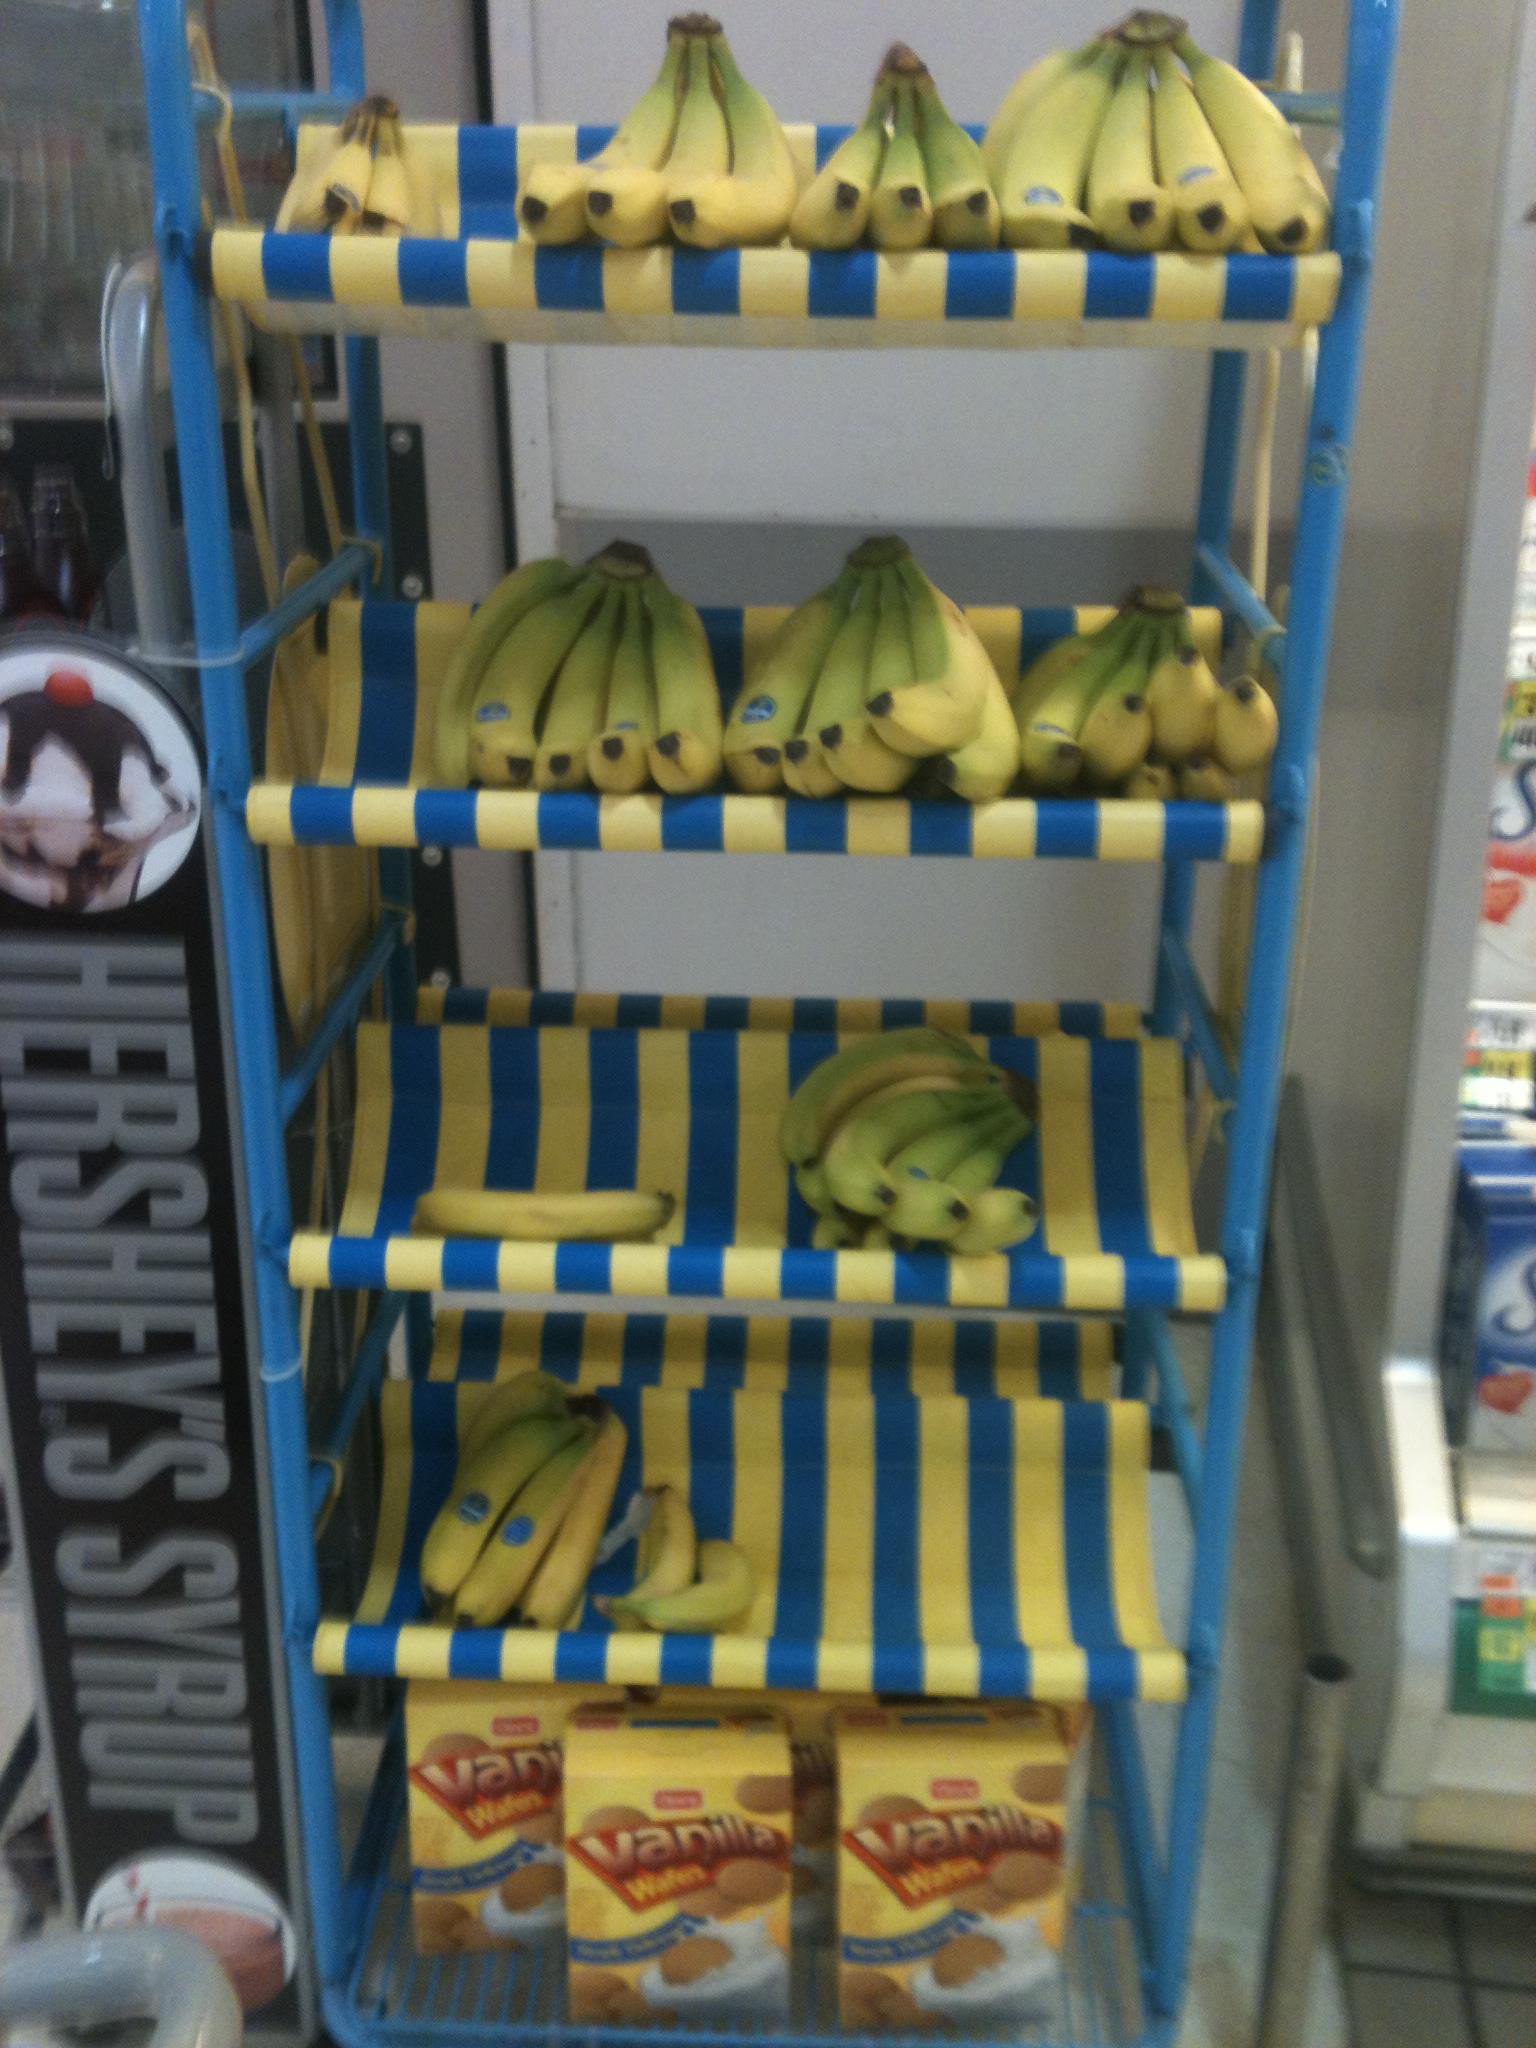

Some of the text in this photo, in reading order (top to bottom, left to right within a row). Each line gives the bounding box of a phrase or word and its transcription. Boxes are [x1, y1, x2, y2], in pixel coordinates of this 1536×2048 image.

[0, 936, 260, 1844] HERSHEY'S SYRUP
[419, 1742, 562, 1804] Vani
[577, 1813, 778, 1880] Vanilla
[853, 1804, 1054, 1874] Vanilla
